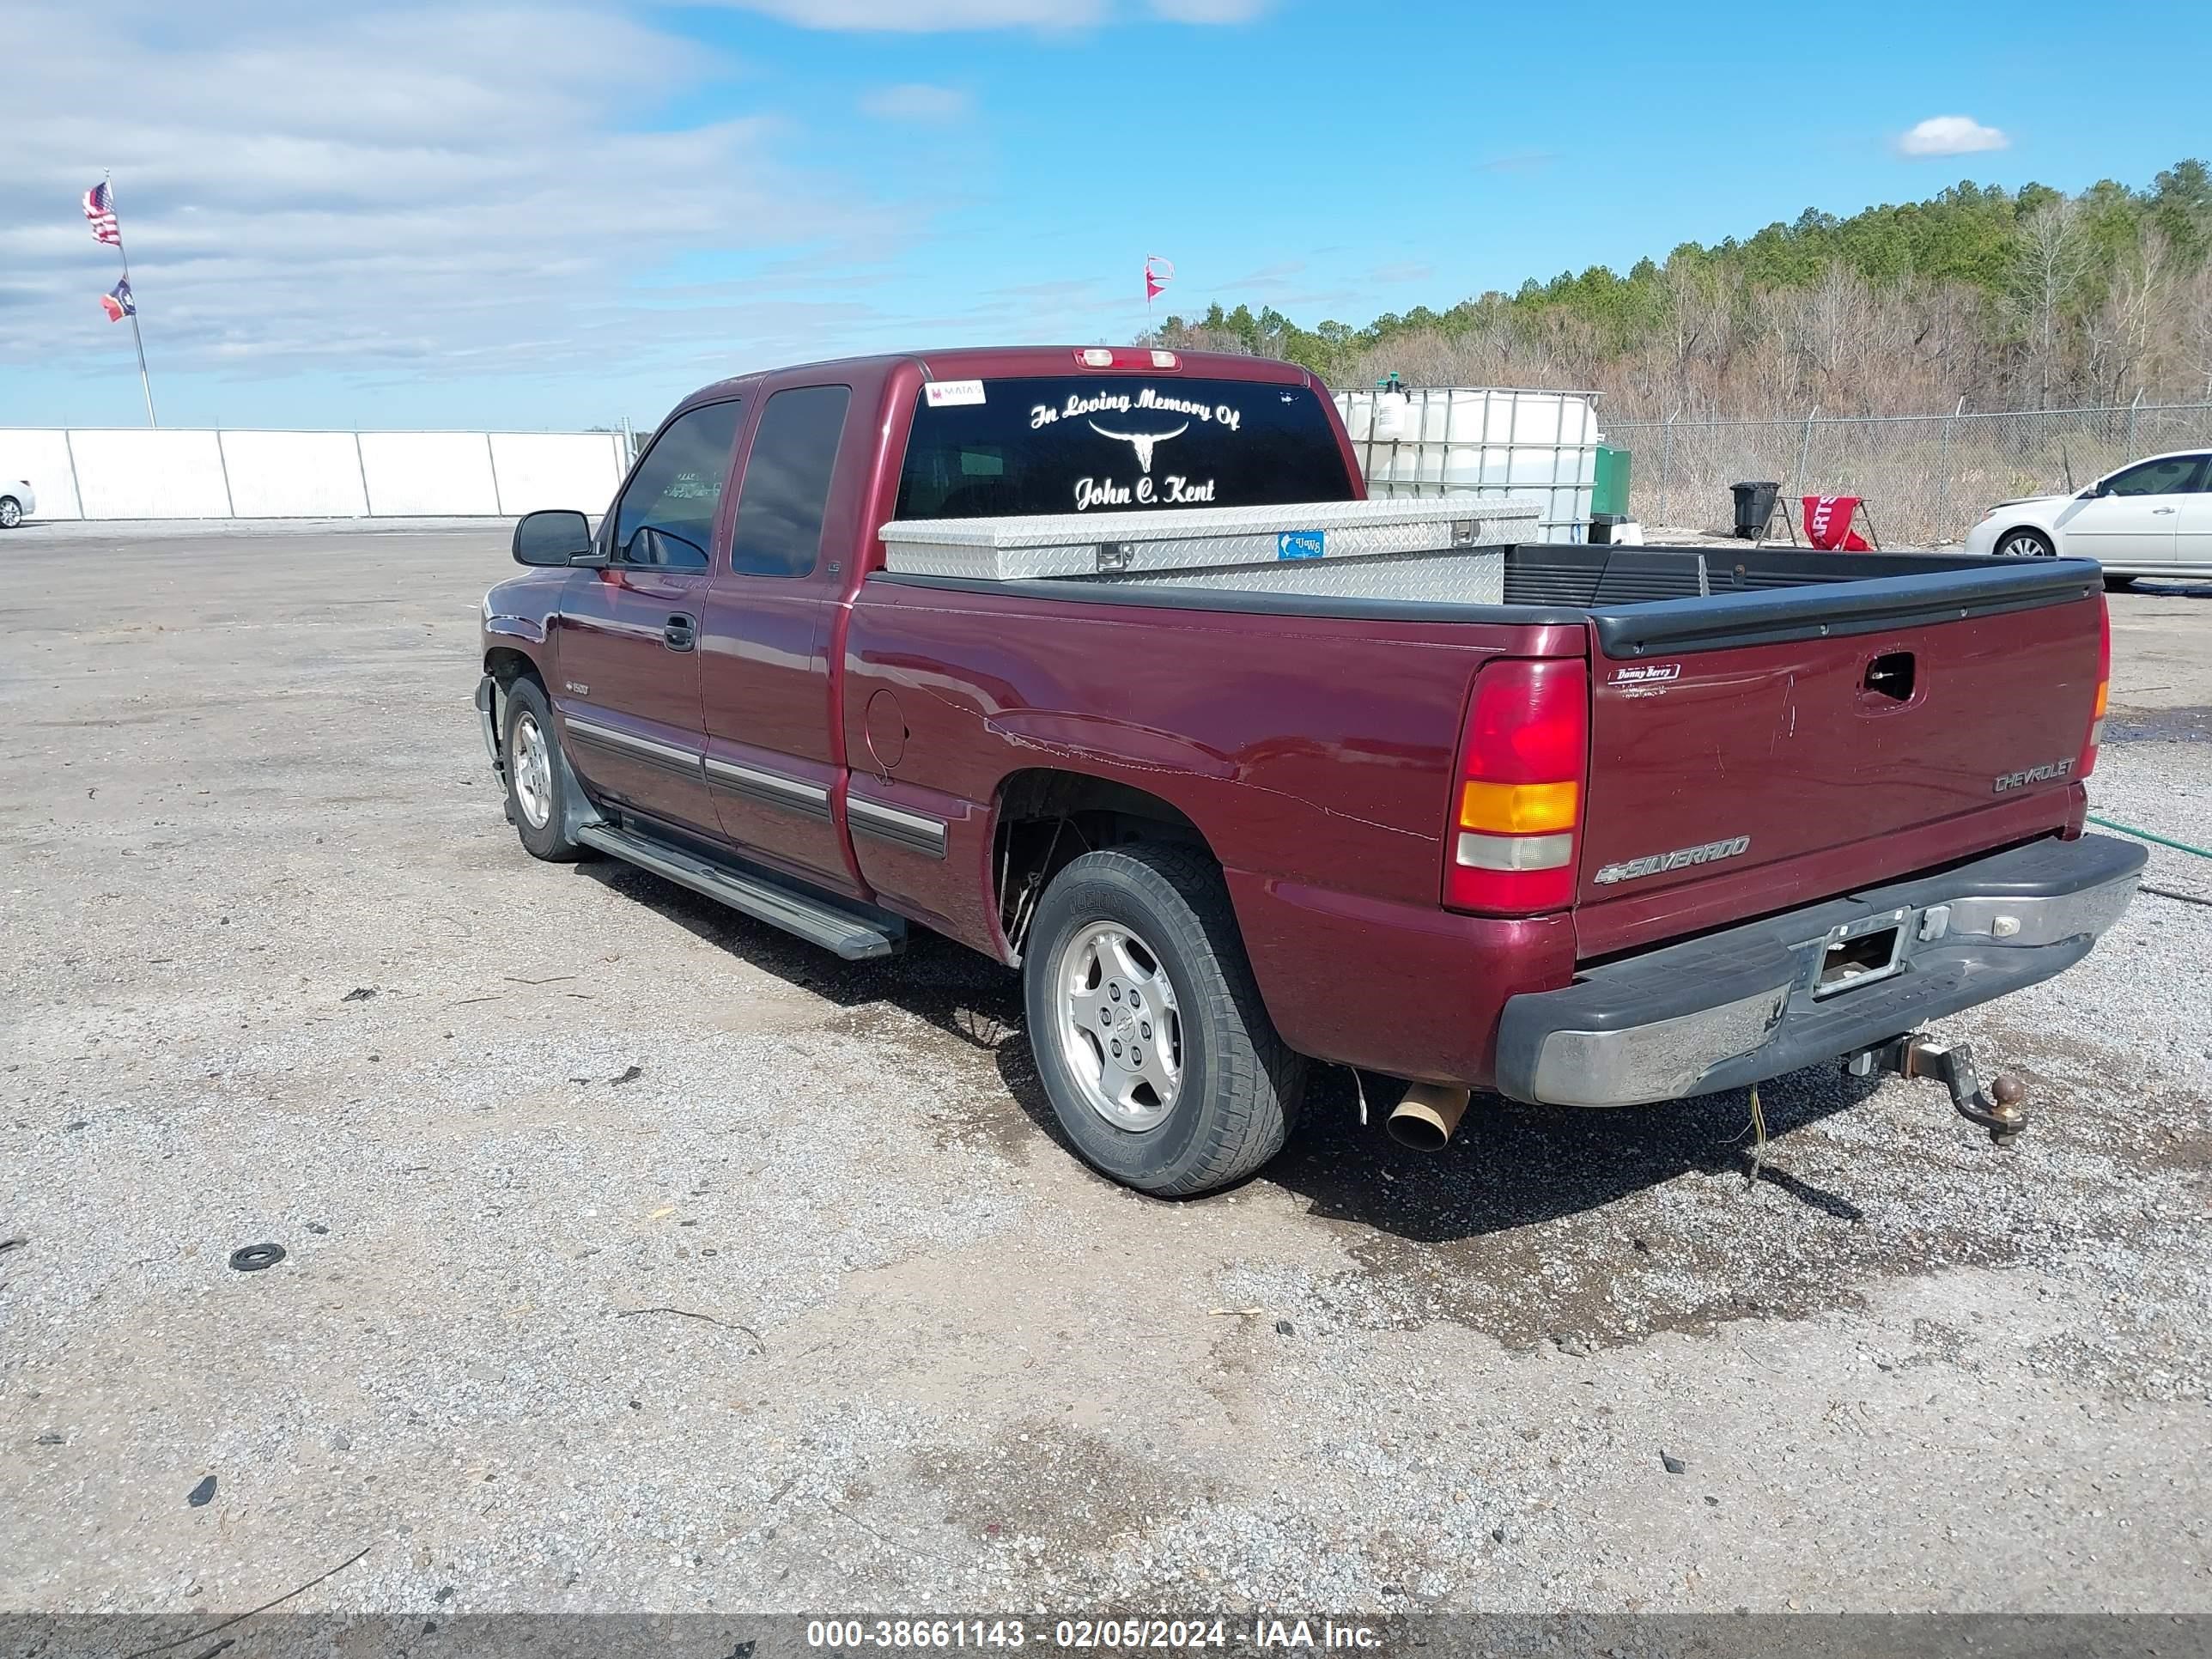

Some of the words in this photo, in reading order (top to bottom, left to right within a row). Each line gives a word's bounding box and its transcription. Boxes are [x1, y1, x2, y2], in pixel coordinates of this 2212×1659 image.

[1030, 405, 1059, 429] In
[1062, 391, 1132, 419] Loving
[1133, 388, 1211, 422] Memory
[1216, 406, 1241, 431] Of
[1074, 476, 1133, 511] John
[1136, 477, 1158, 505] C.
[1162, 475, 1216, 504] Kent
[1295, 538, 1321, 554] UWS
[1992, 757, 2076, 793] CHEVROLET
[1622, 835, 1752, 878] SILVERADO
